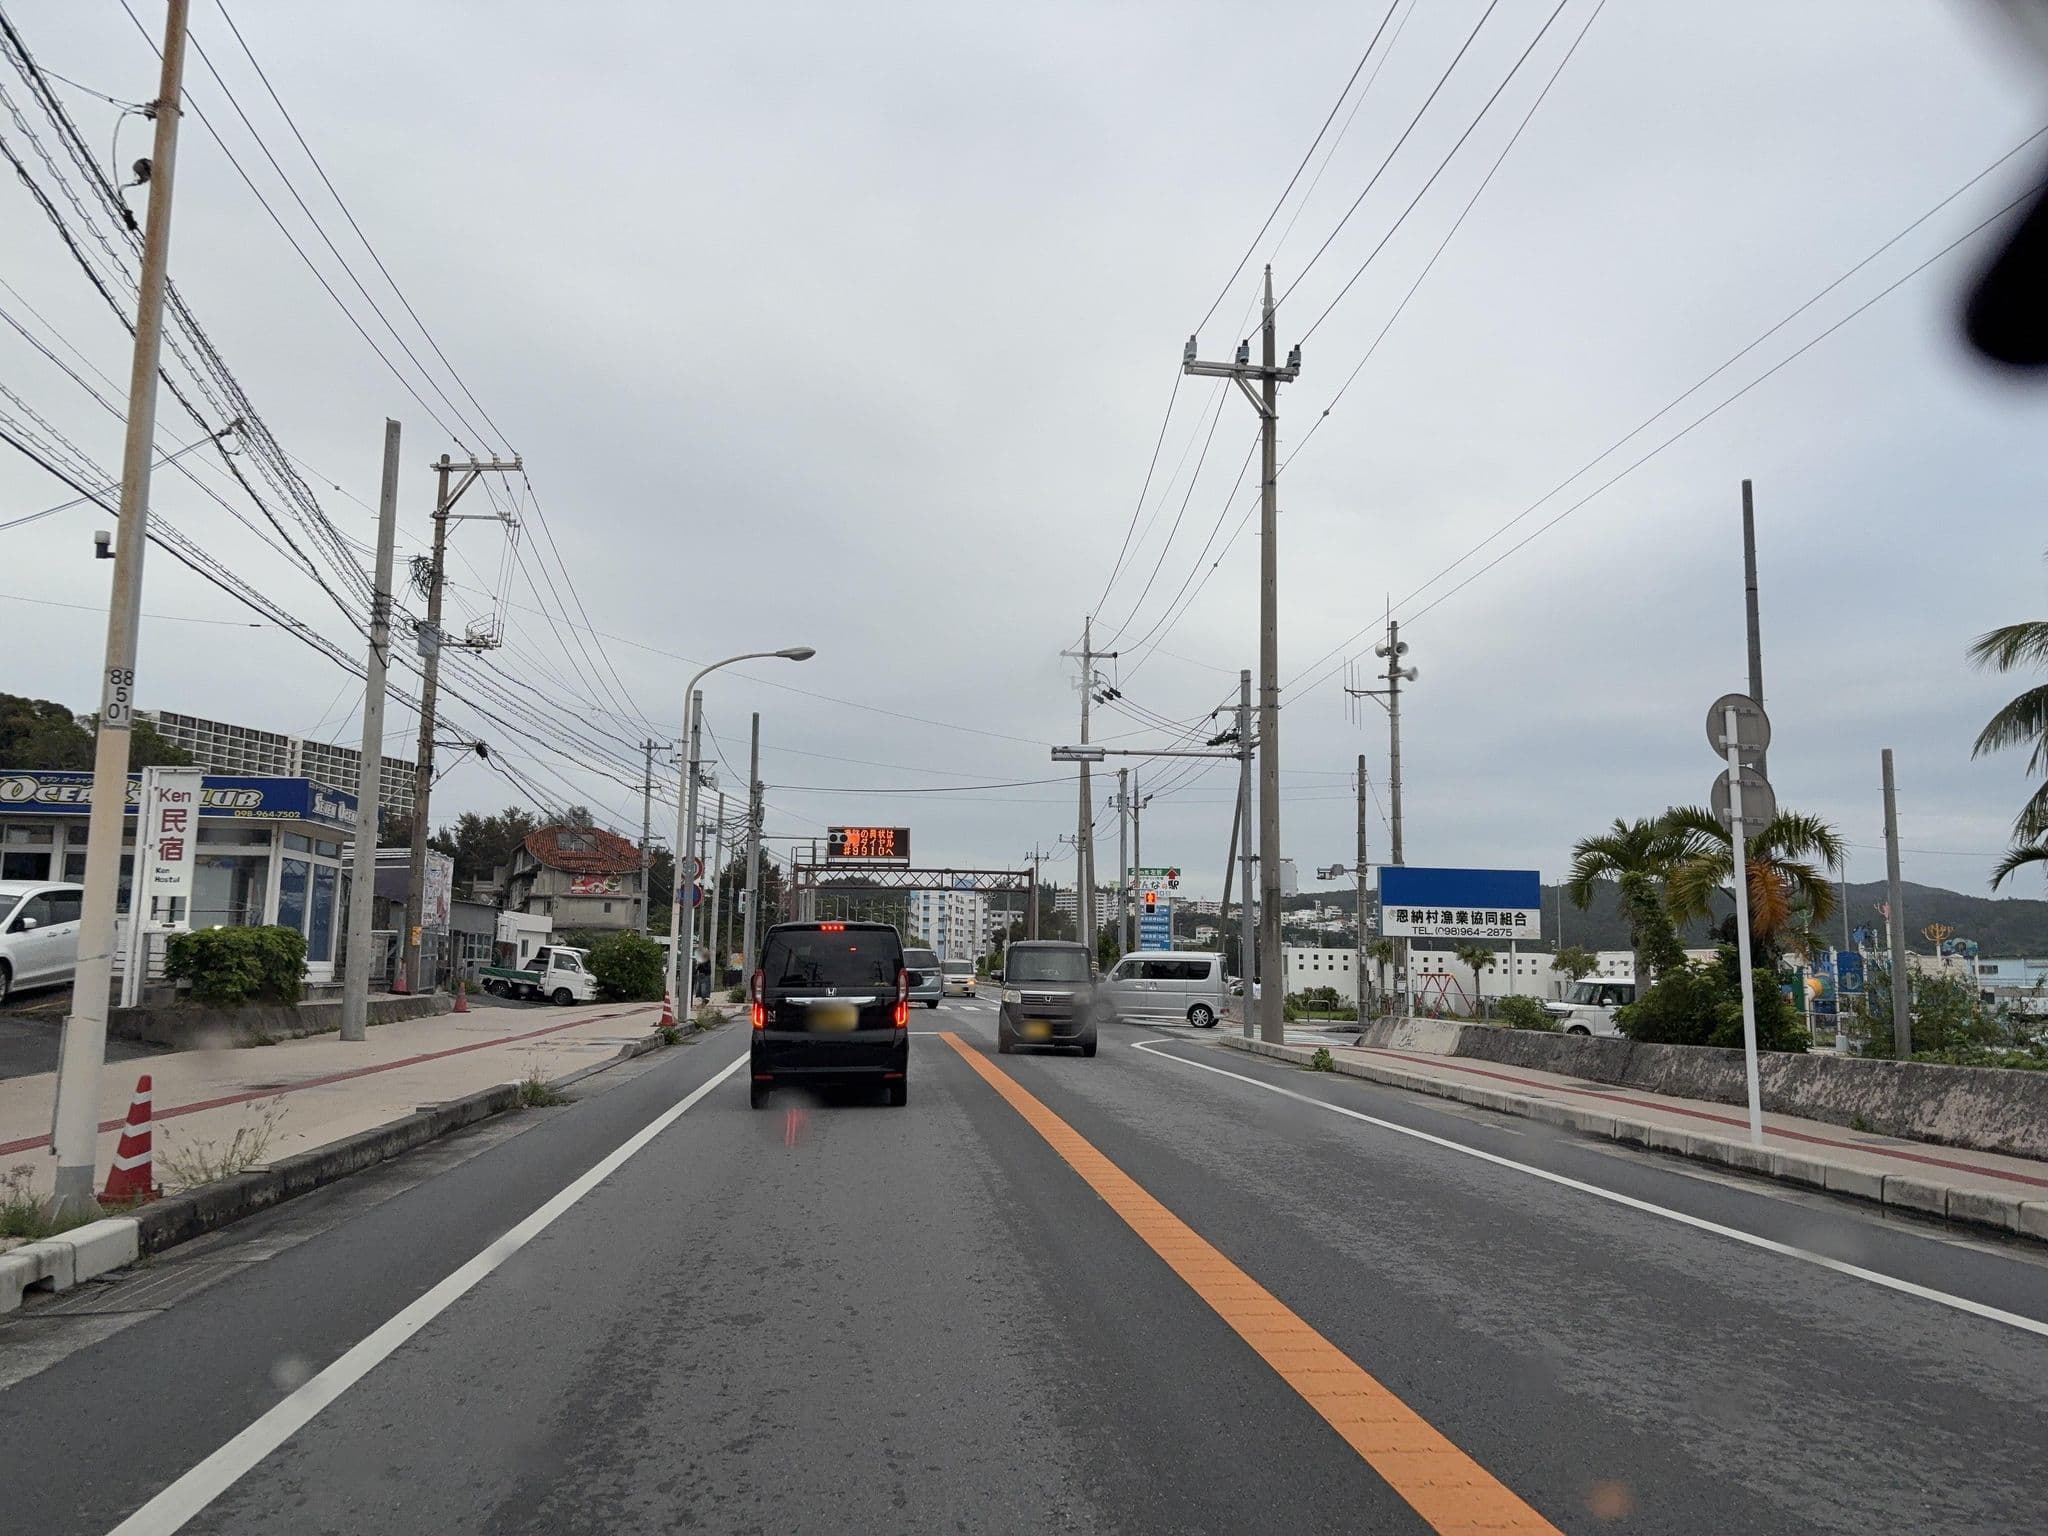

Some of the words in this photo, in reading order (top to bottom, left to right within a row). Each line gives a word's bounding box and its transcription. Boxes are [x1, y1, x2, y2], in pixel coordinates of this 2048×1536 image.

[111, 669, 134, 686] 88
[116, 687, 127, 702] 5
[108, 703, 129, 720] 01
[159, 787, 191, 802] Ken
[234, 810, 301, 818] 098-964-7502
[159, 808, 187, 861] 民宿
[1396, 909, 1527, 926] 恩納村漁業協同組合
